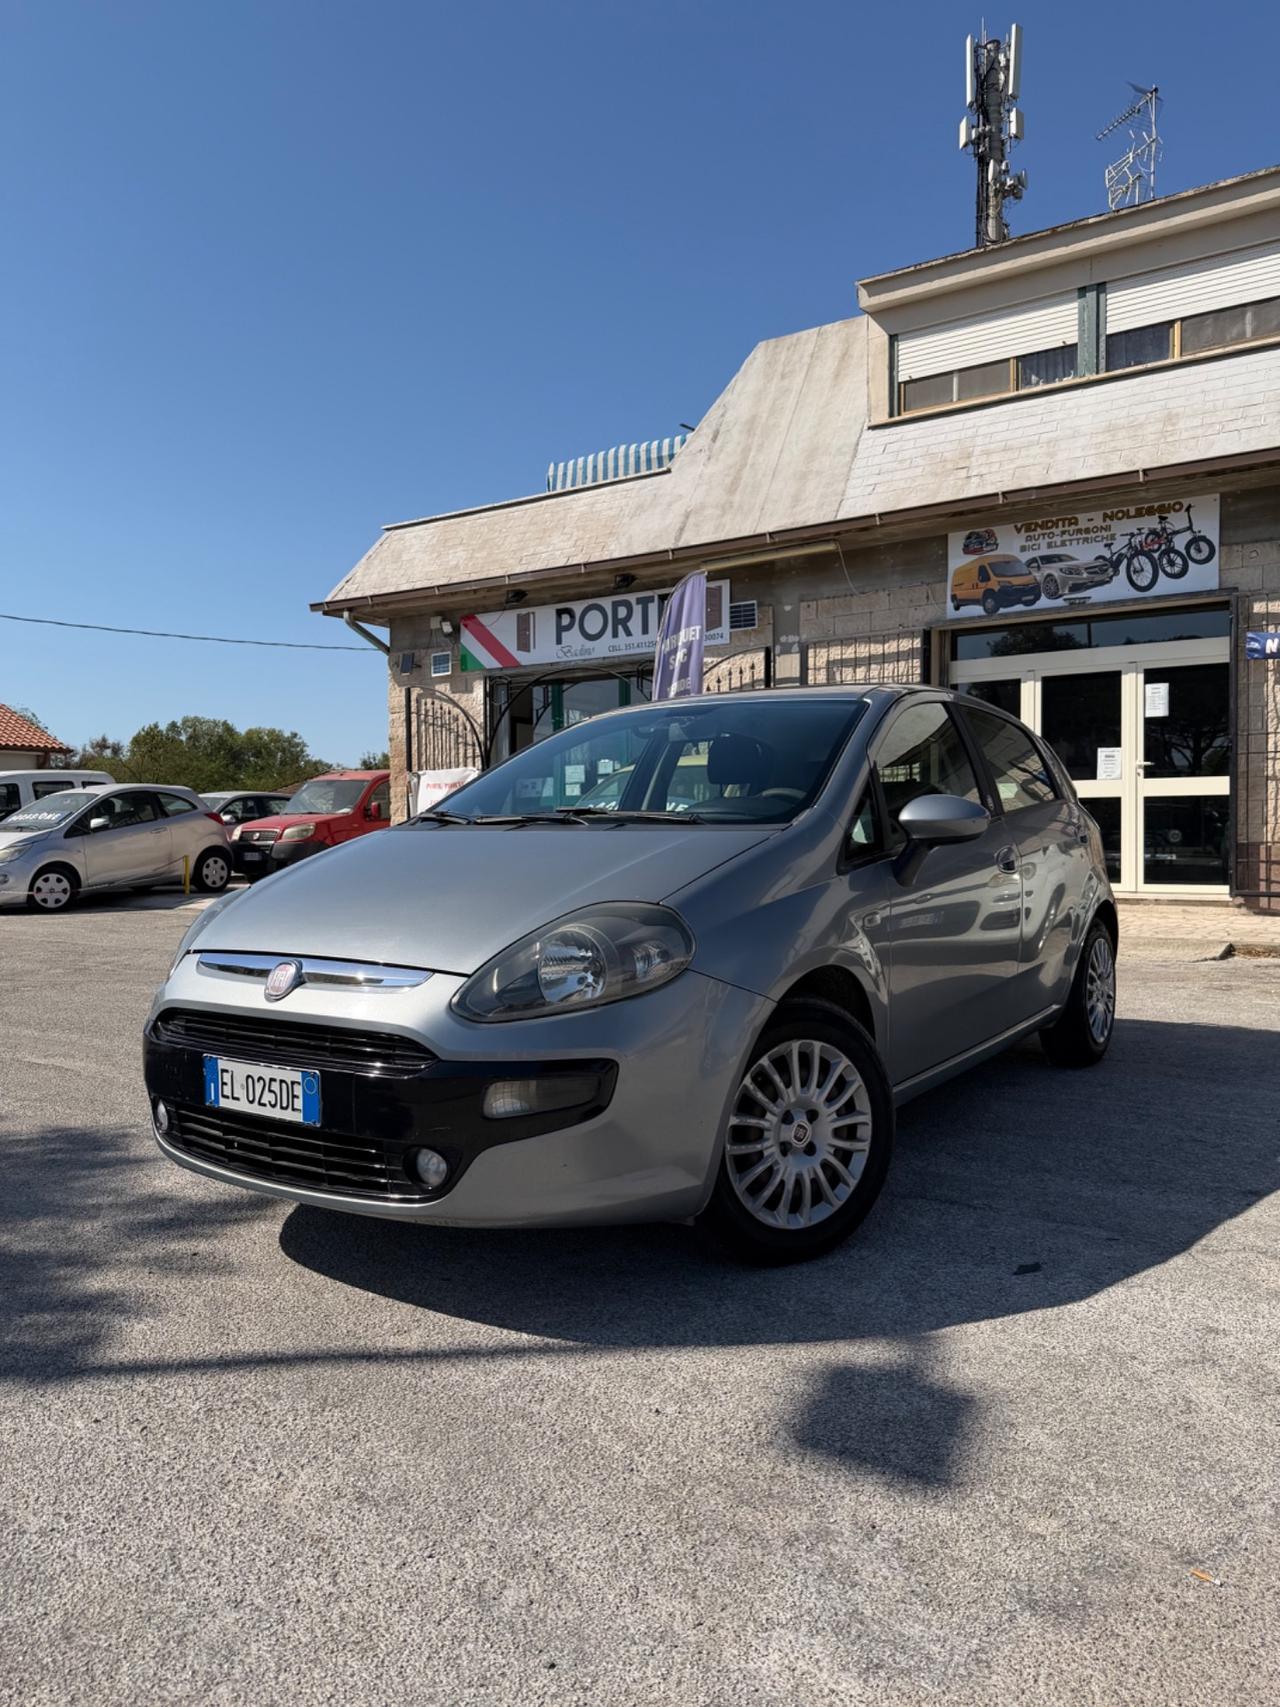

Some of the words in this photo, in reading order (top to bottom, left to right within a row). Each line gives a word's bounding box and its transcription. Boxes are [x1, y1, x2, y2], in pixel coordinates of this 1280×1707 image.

[1014, 516, 1079, 535] VENDITA
[1102, 501, 1184, 523] NOLEGGIO
[1025, 524, 1112, 543] AUTO-FURGONI
[1019, 543, 1041, 552] BICI
[1046, 533, 1117, 550] ELETTRICHE
[555, 594, 667, 645] PORT
[220, 1068, 240, 1101] EL
[245, 1074, 302, 1112] 025DE
